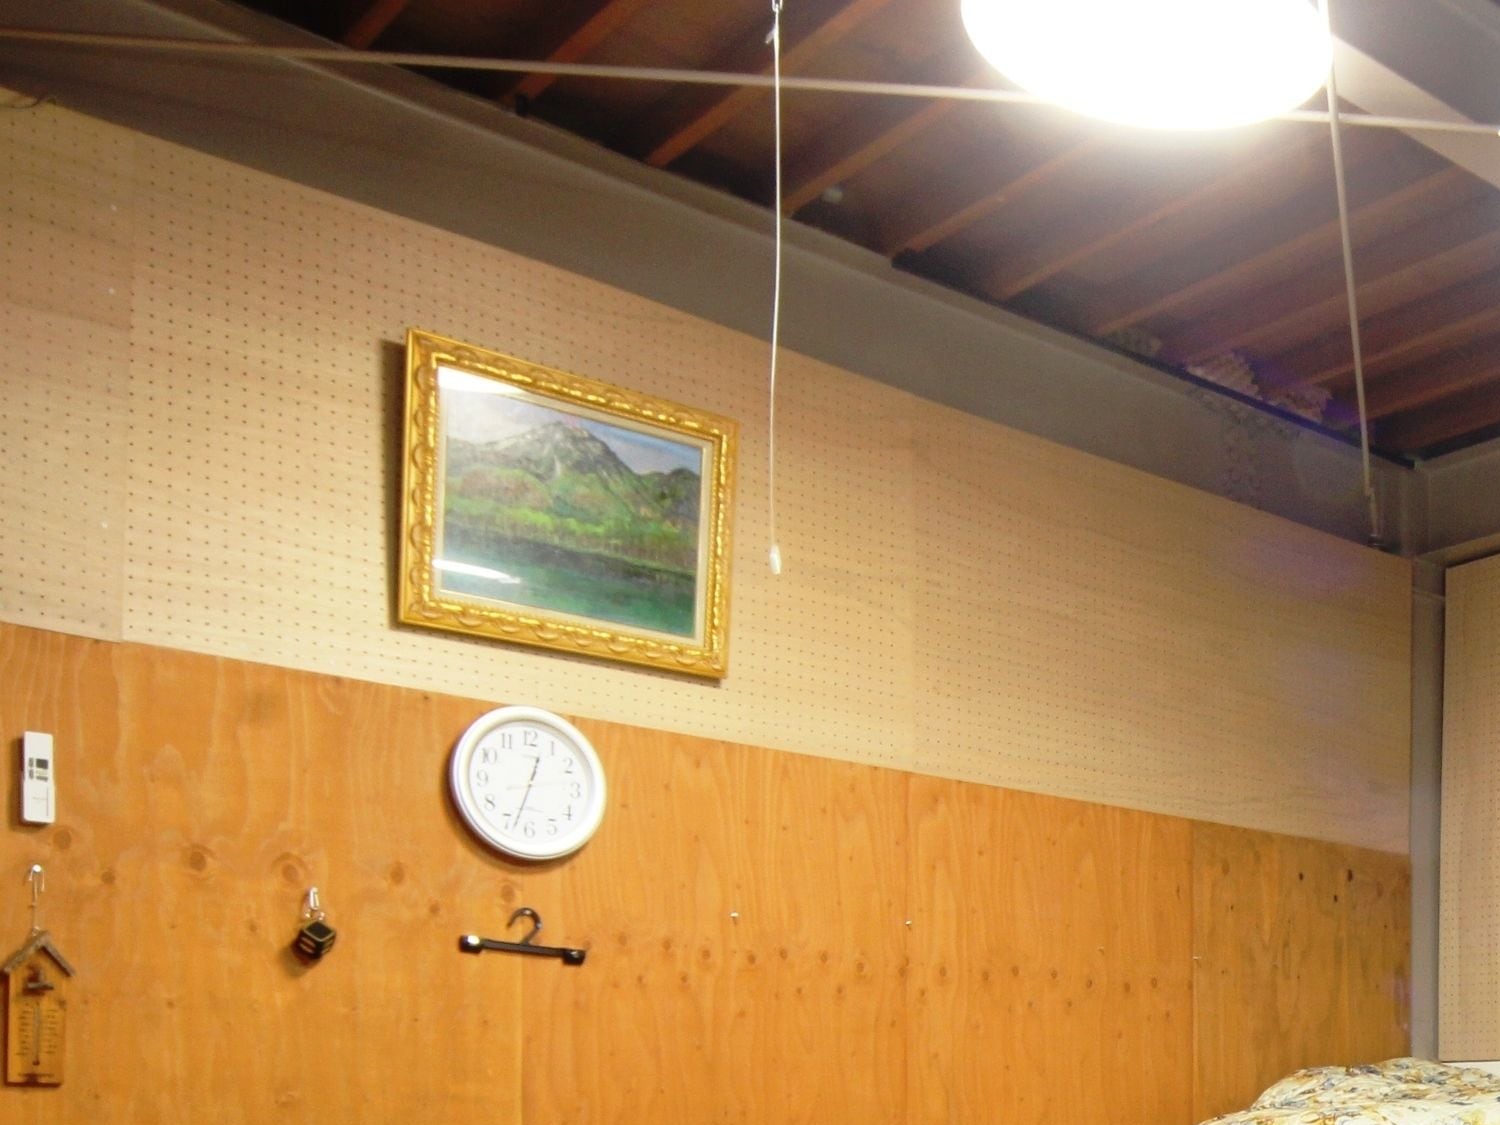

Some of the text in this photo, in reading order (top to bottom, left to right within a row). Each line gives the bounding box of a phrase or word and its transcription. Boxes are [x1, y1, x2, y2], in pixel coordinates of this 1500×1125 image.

[501, 733, 513, 750] 11
[522, 731, 538, 747] 12
[481, 747, 497, 764] 10
[563, 757, 573, 774] 2
[476, 770, 489, 786] 9
[570, 782, 581, 798] 3
[484, 794, 496, 810] 8
[562, 805, 573, 821] 4
[523, 821, 536, 838] 6
[546, 818, 557, 835] 5
